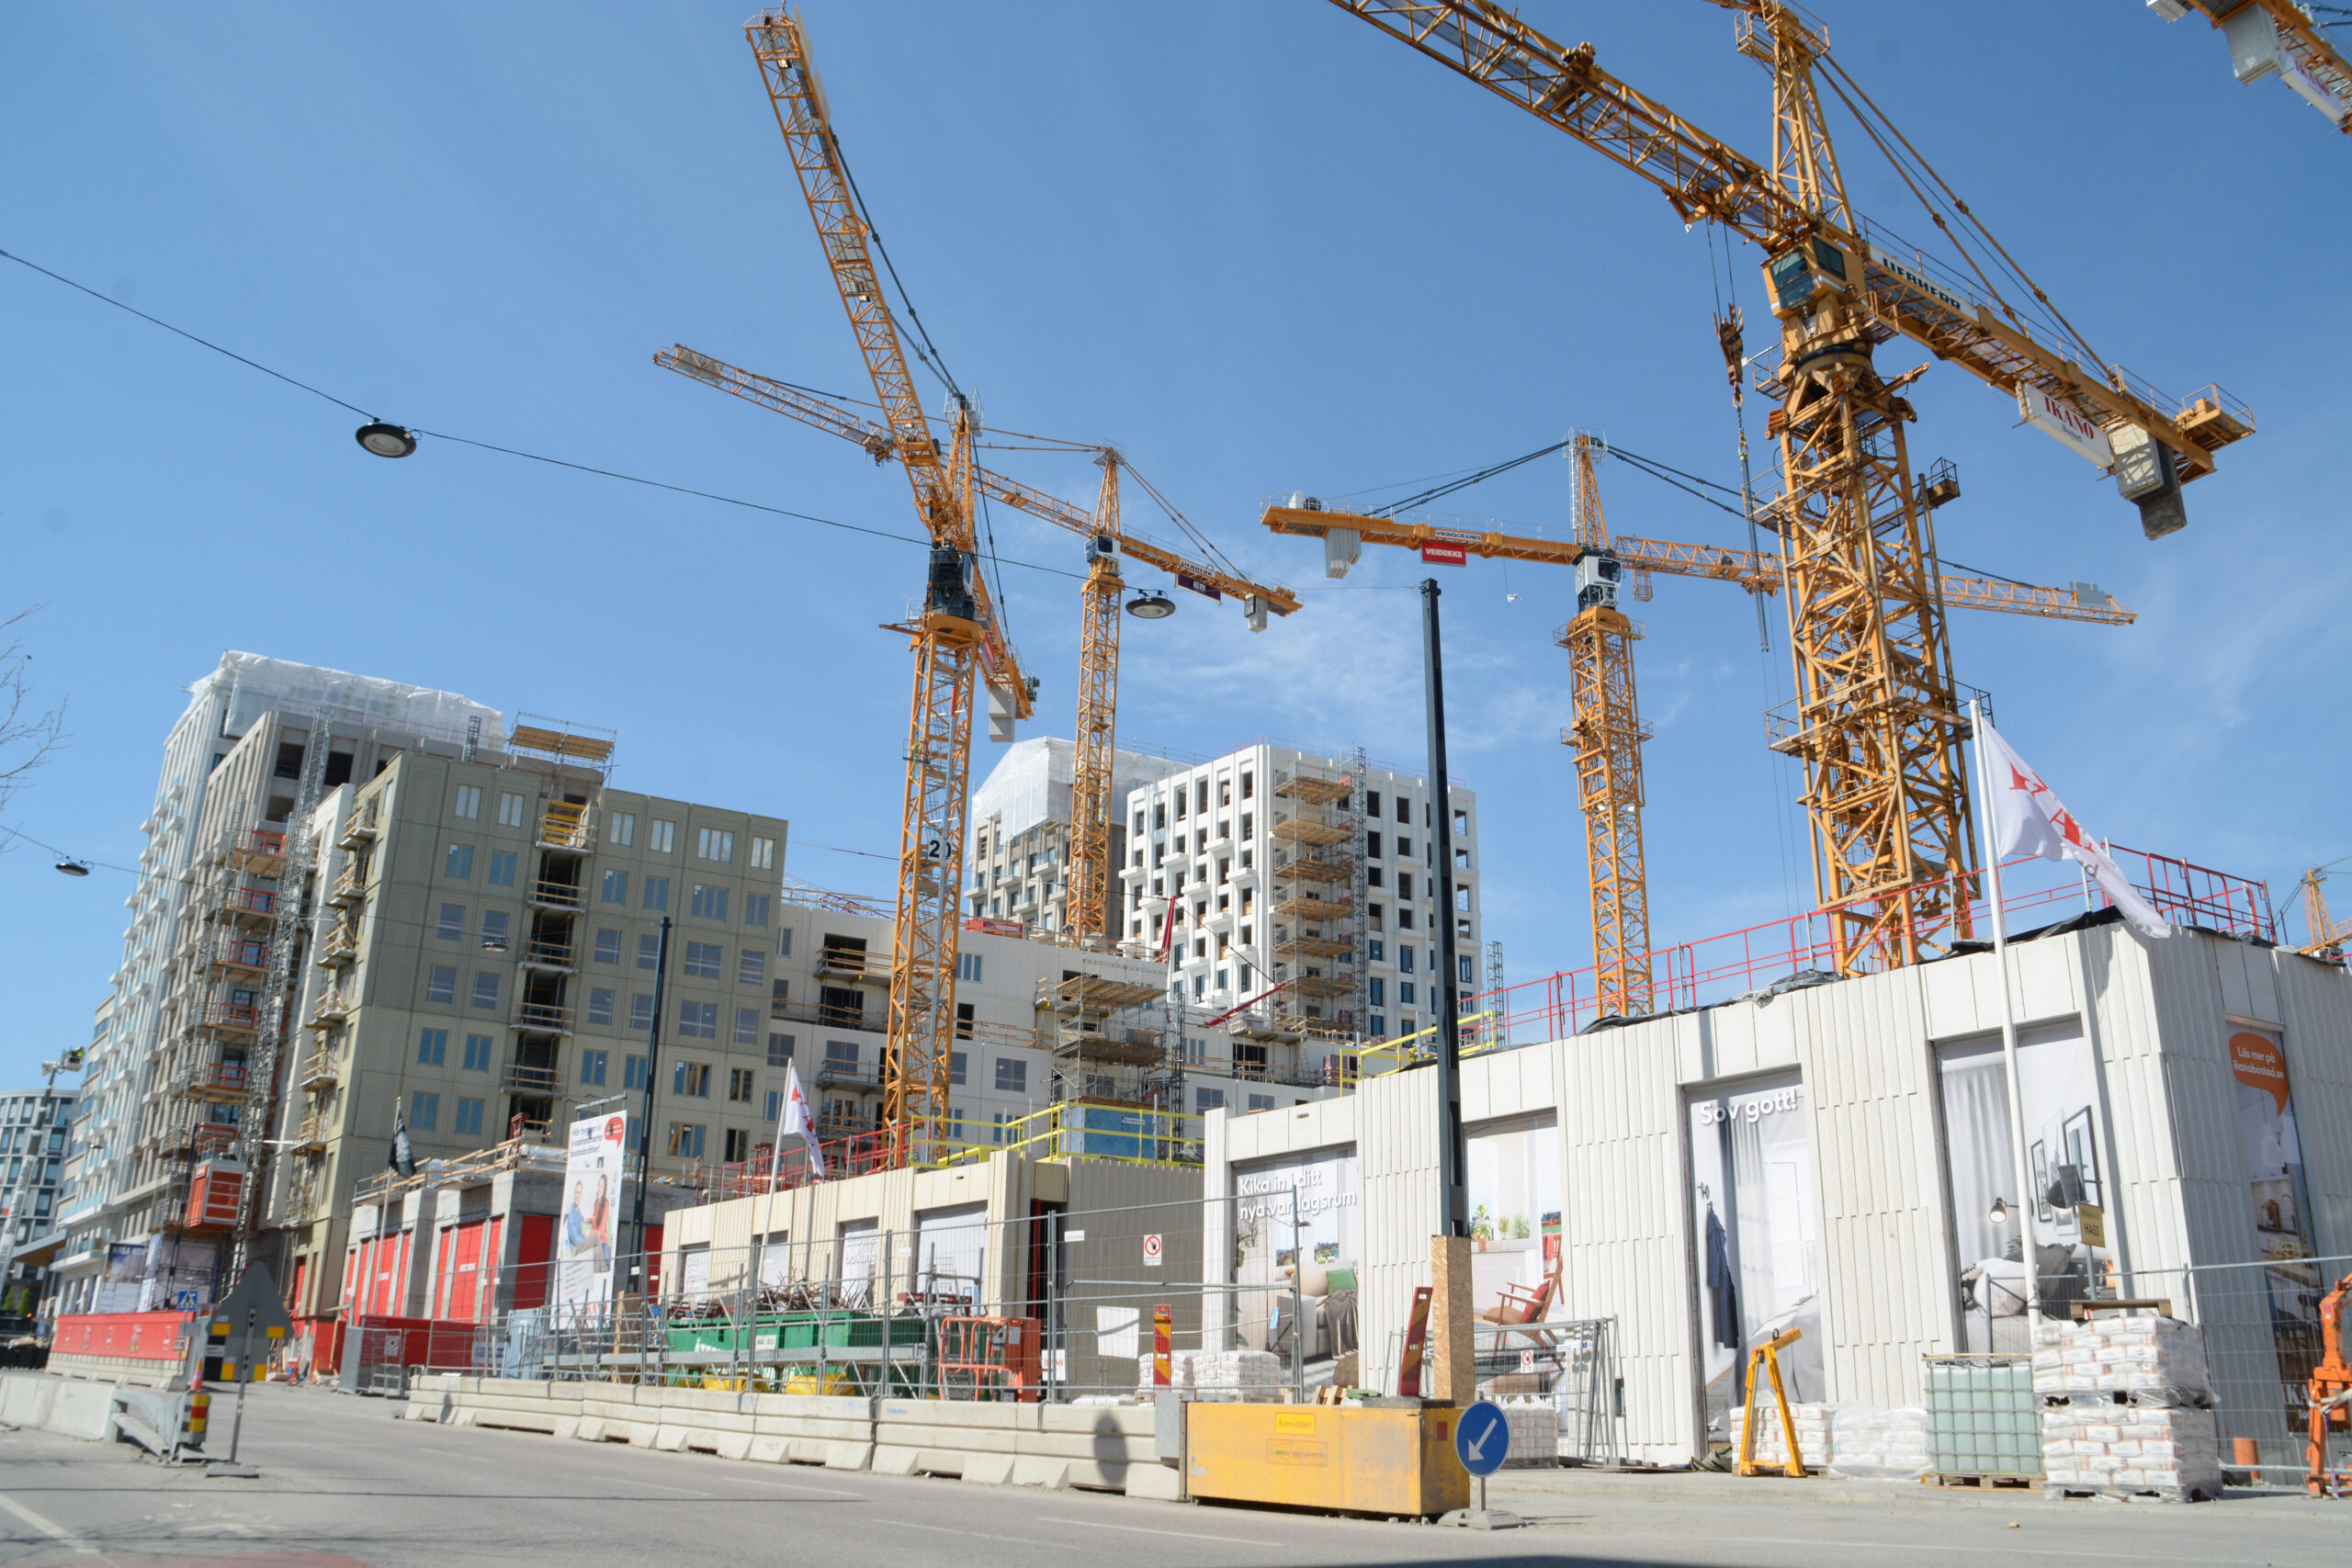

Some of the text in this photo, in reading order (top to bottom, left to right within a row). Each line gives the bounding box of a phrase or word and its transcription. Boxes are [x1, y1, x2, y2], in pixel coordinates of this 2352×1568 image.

[1883, 257, 1962, 310] LIEBHERR
[2044, 395, 2094, 440] IKANO
[1435, 530, 1481, 541] VIKINGCRANES
[1425, 547, 1463, 558] VEIDEKKE
[2236, 1045, 2276, 1065] Läs mer på
[2233, 1059, 2285, 1079] ikanobostad.se
[1701, 1088, 1798, 1125] Sov gott!
[1239, 1177, 1271, 1197] Kika
[1275, 1176, 1286, 1191] in
[1299, 1168, 1322, 1188] ditt
[1240, 1205, 1266, 1224] nya
[2281, 1383, 2312, 1406] IKA
